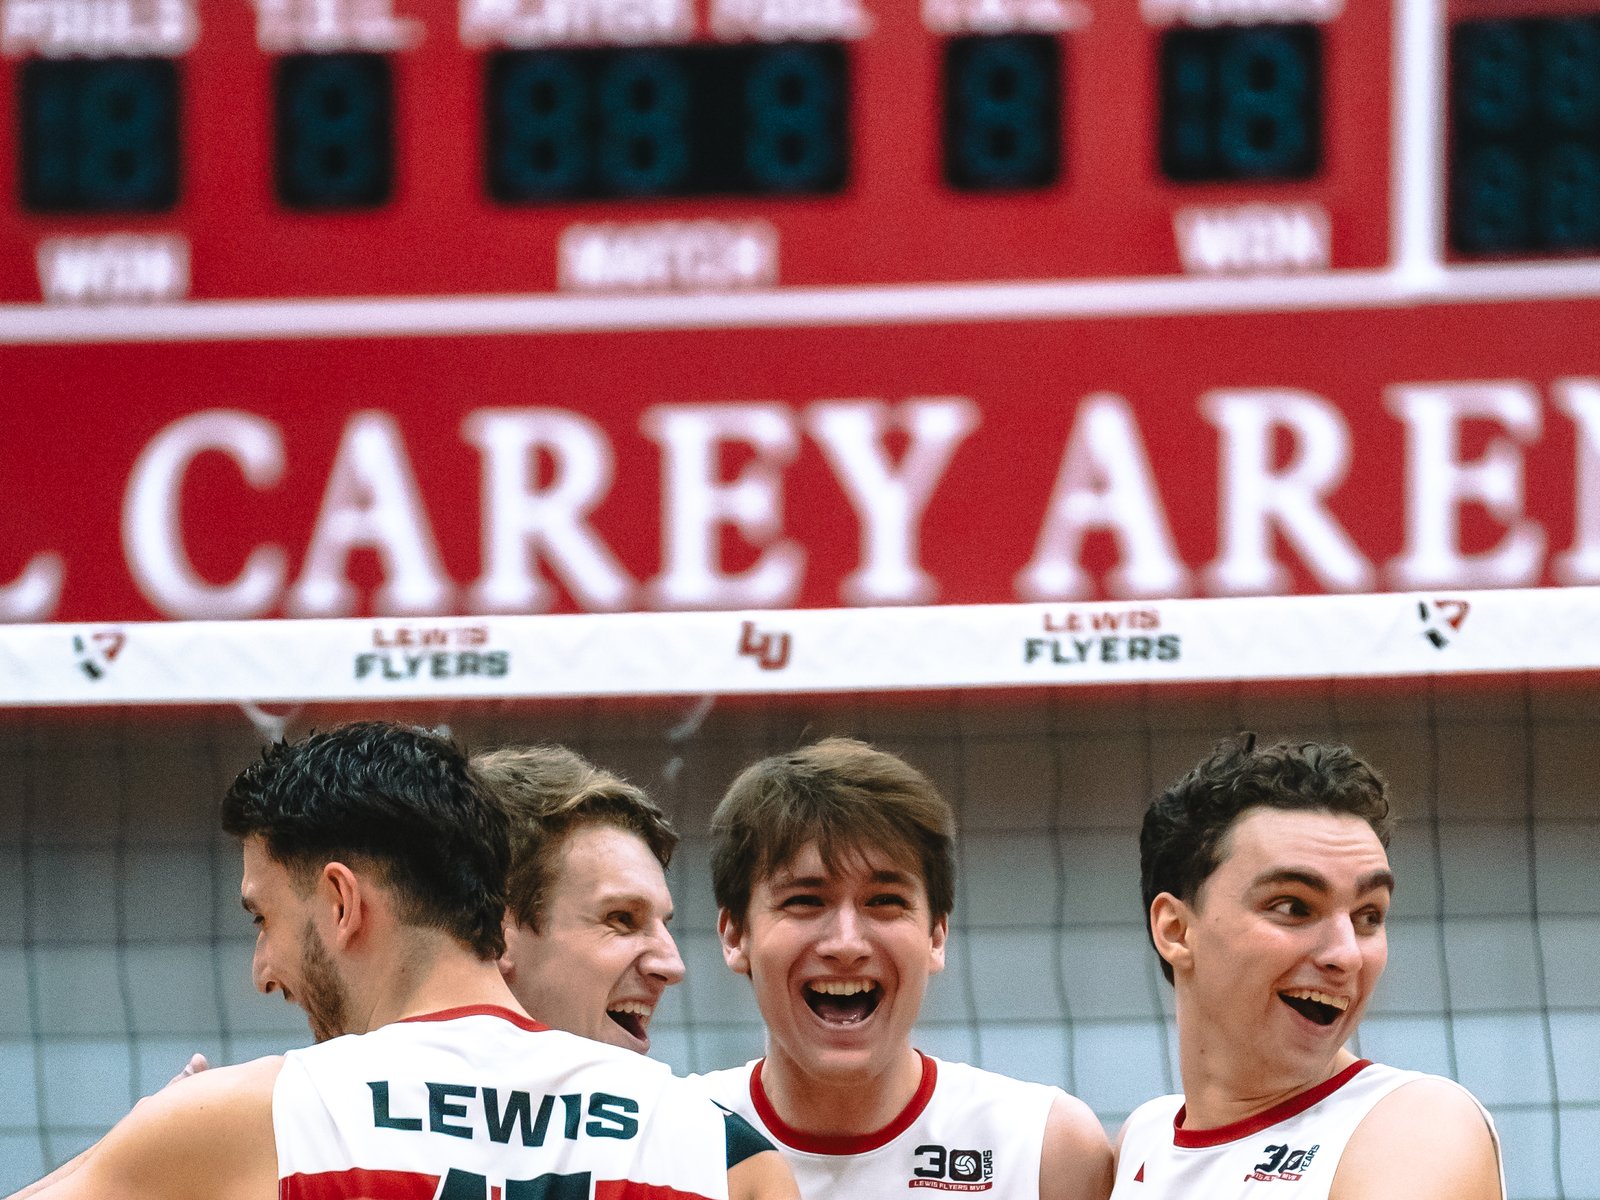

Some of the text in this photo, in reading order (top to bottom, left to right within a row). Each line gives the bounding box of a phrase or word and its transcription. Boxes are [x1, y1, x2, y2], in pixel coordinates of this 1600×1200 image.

[121, 396, 983, 620] CAREY
[1043, 610, 1161, 632] LEWIS
[372, 625, 488, 648] LEWIS
[739, 620, 792, 671] LU
[1023, 634, 1182, 664] FLYERS
[354, 650, 511, 680] FLYERS
[367, 1081, 640, 1147] LEWIS
[983, 1149, 993, 1182] YEARS
[1298, 1144, 1320, 1173] YEARS
[914, 1180, 938, 1188] LEWIS
[939, 1182, 968, 1191] FLYERS
